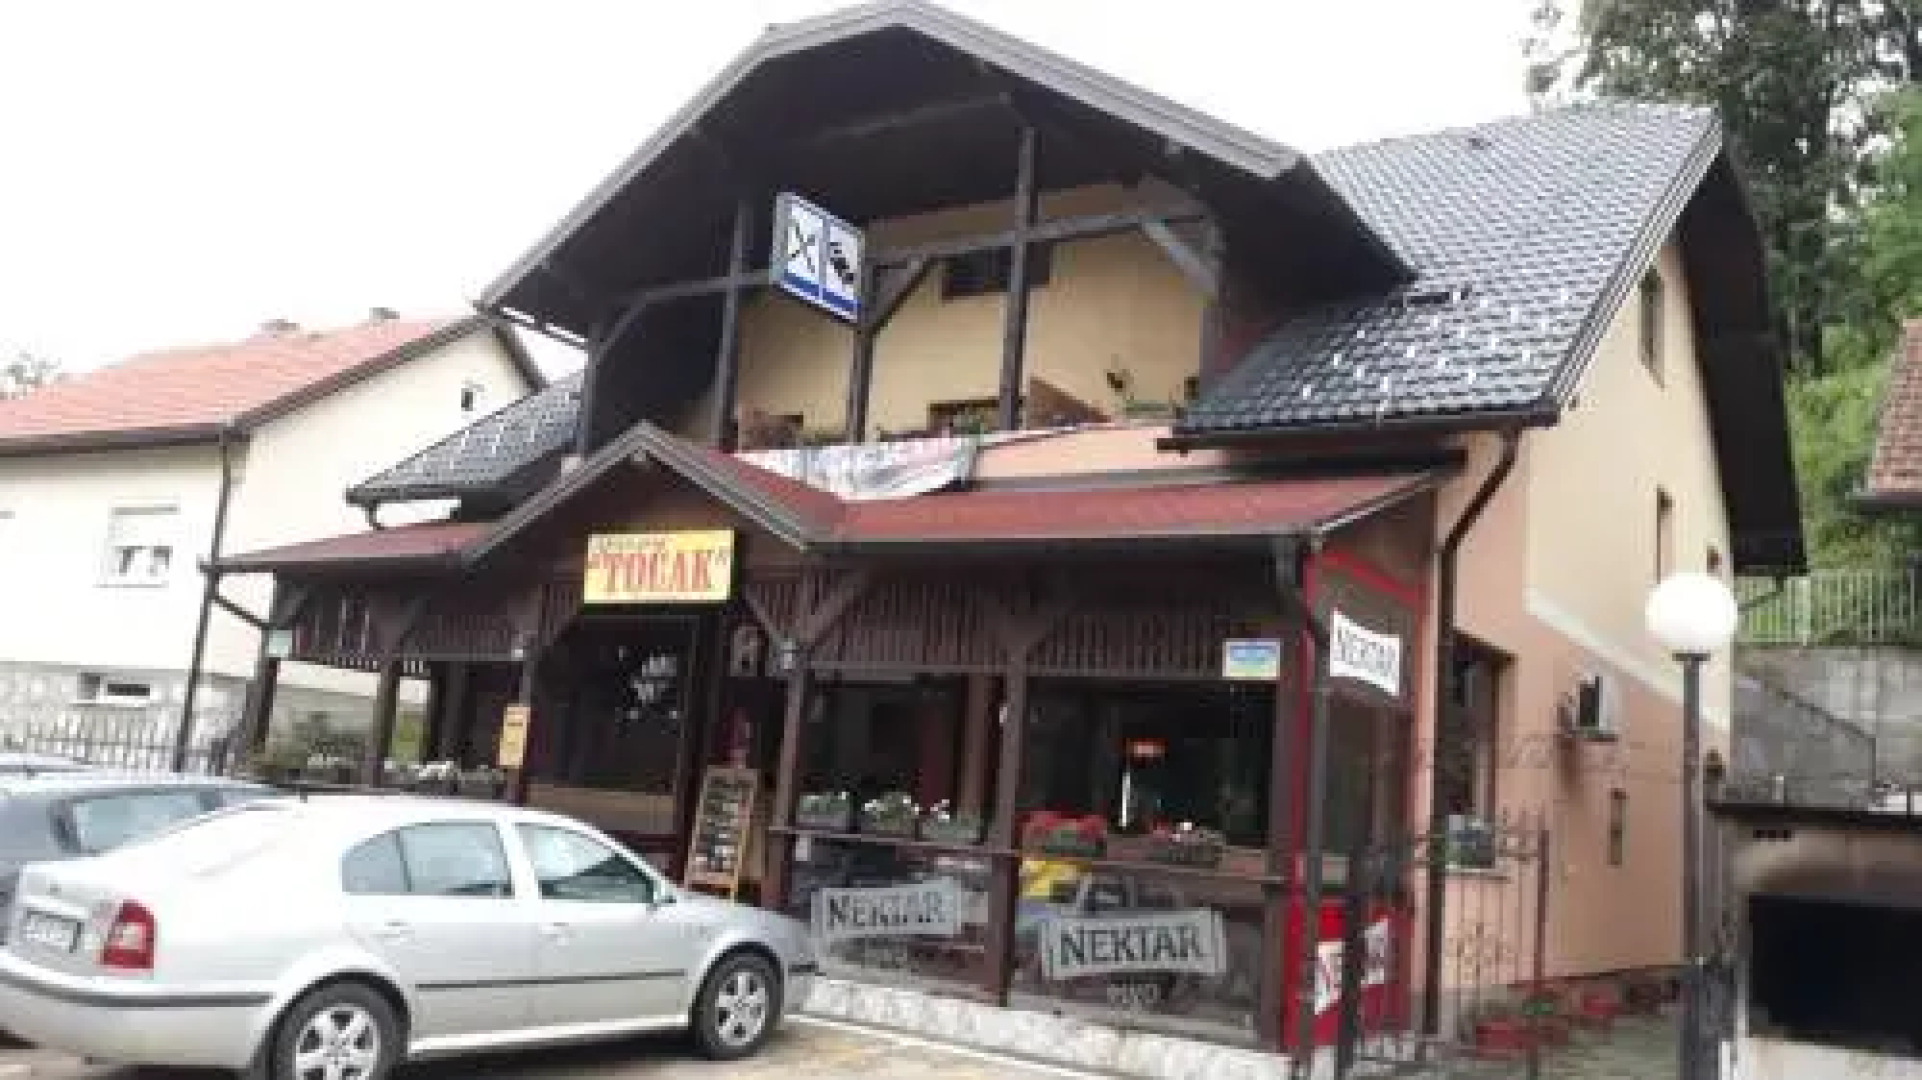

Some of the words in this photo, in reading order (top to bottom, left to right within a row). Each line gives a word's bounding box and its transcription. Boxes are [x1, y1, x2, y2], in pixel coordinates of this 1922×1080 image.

[1333, 625, 1398, 681] NEKTAR
[828, 887, 946, 928] NEKTAR
[1060, 921, 1203, 965] NEKTAR
